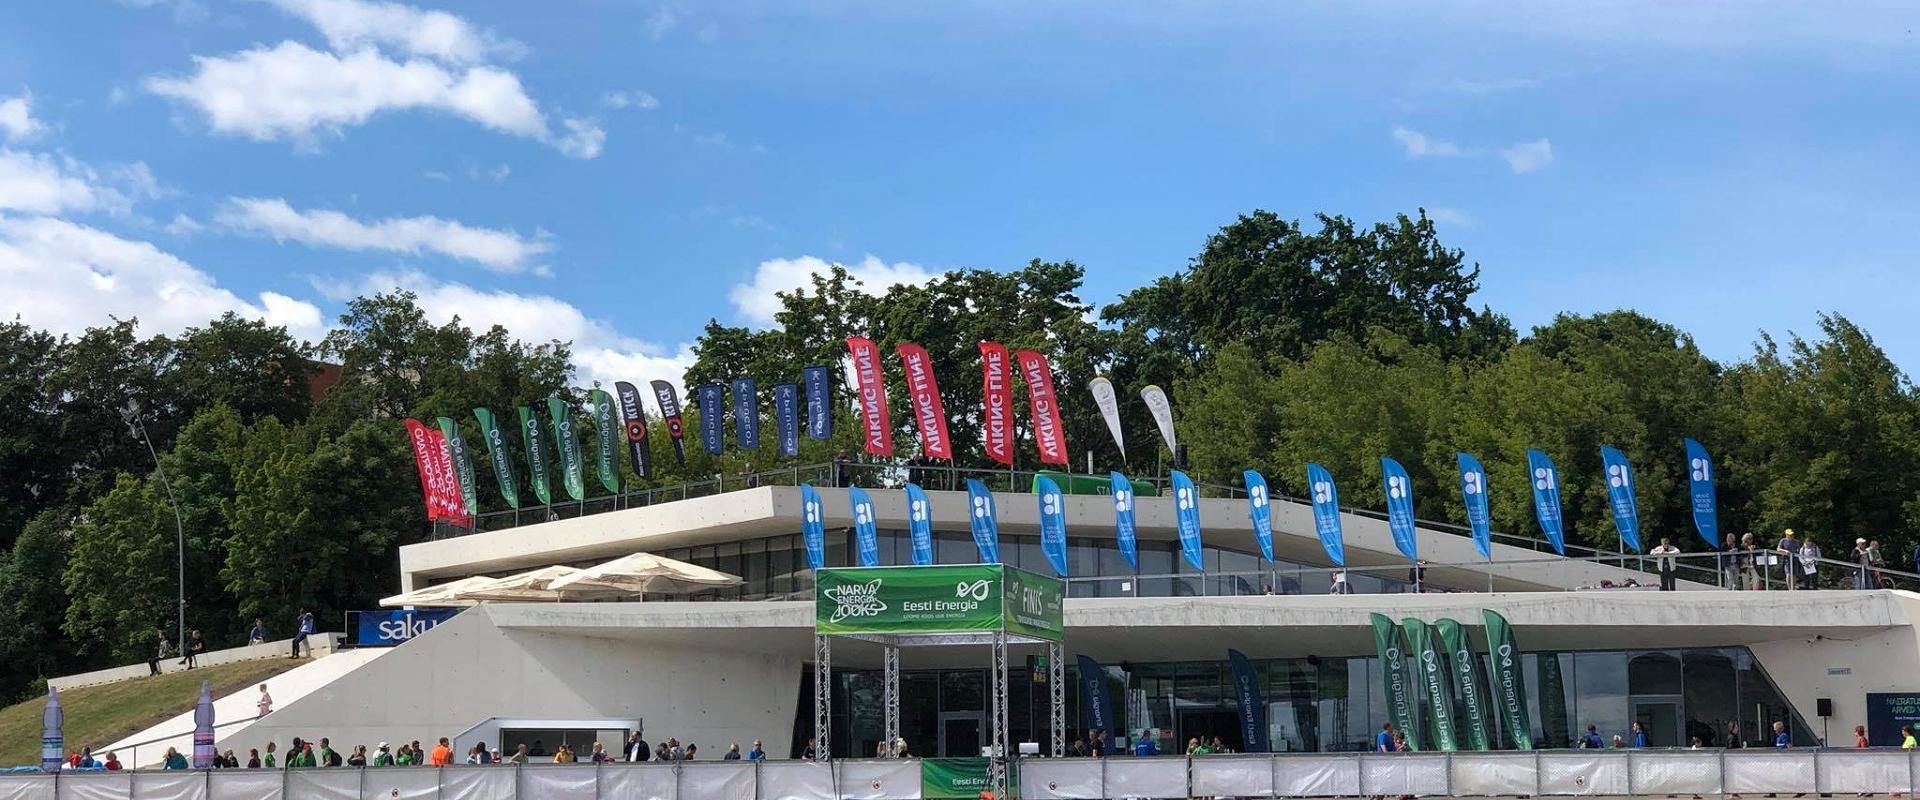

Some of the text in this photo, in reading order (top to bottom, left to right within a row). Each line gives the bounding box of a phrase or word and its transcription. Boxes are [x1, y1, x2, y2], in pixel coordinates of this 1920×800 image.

[836, 584, 877, 596] NARVA
[837, 595, 876, 604] ENERGIA
[903, 599, 978, 612] Eesti Energia
[836, 603, 878, 617] JOOKS
